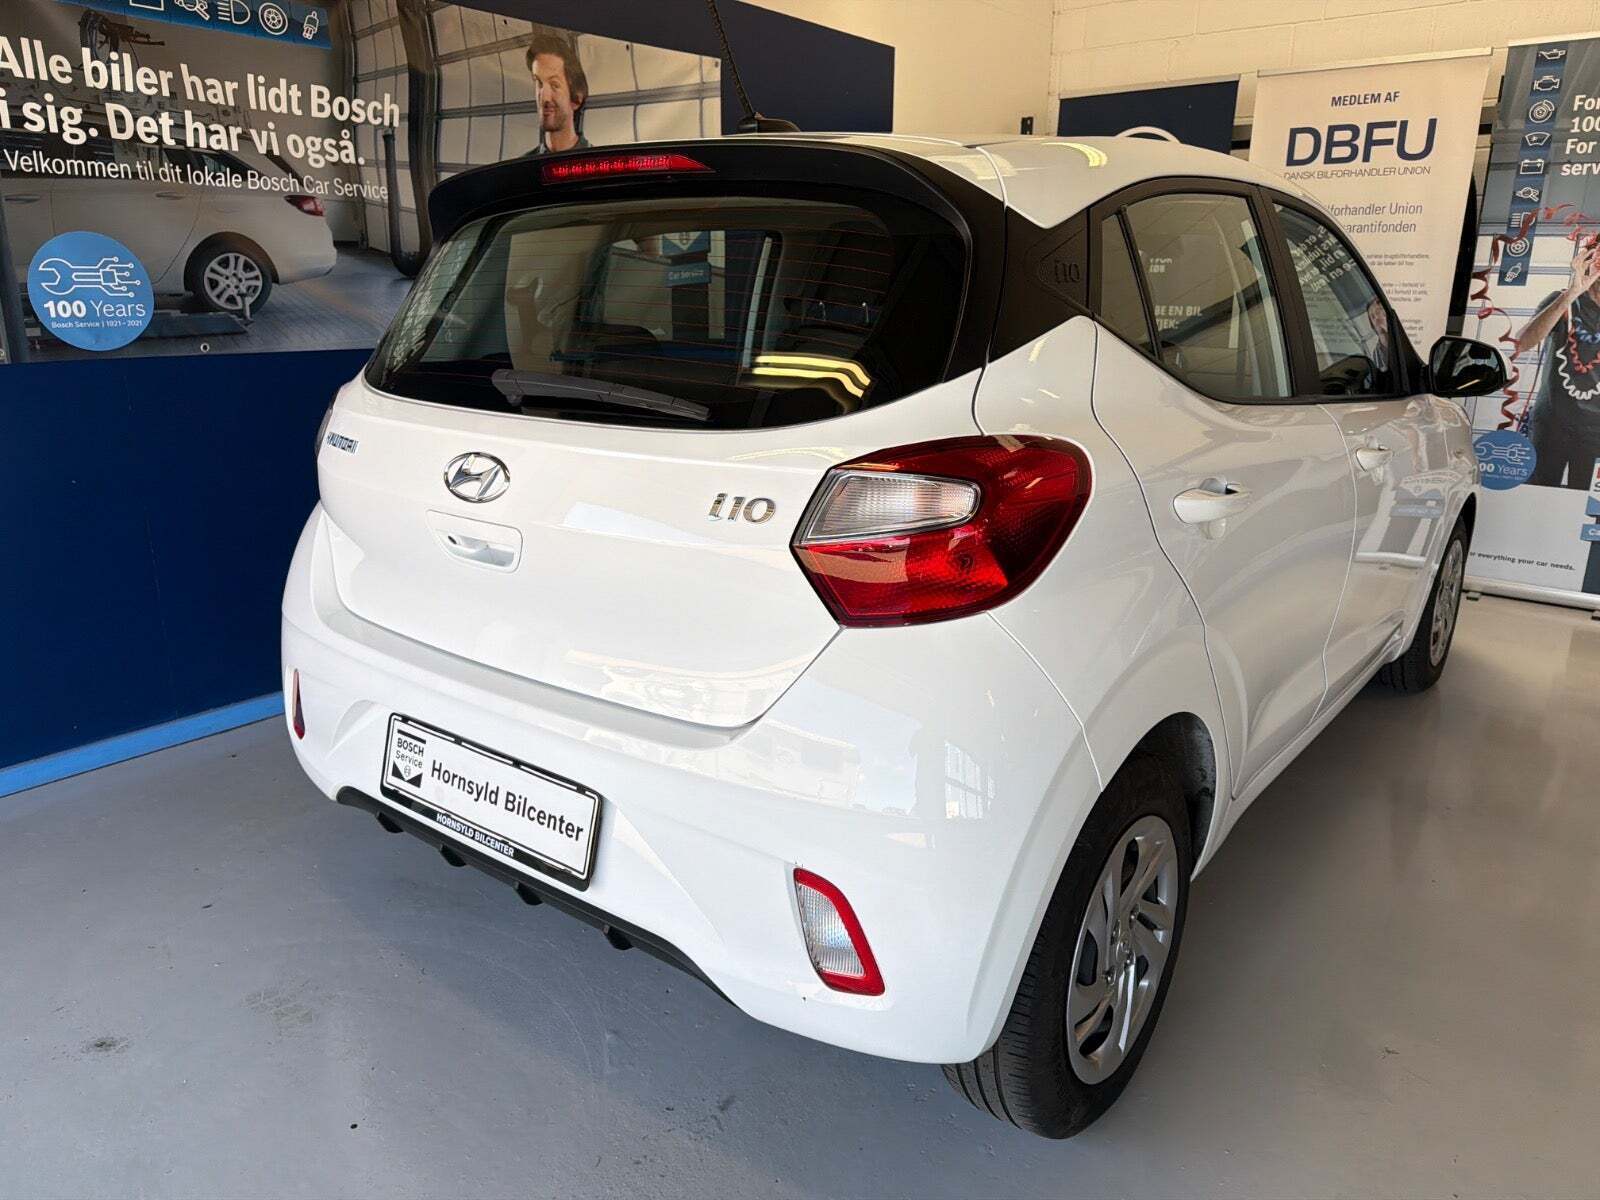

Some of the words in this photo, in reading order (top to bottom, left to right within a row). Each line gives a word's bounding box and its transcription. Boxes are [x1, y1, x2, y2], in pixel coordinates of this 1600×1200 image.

[0, 36, 73, 84] Alle
[81, 47, 174, 97] biler
[180, 63, 239, 107] har
[246, 73, 304, 116] lidt
[310, 83, 400, 128] Bosch
[1330, 92, 1382, 107] MEDLEM
[1384, 91, 1400, 104] AF
[0, 87, 11, 129] i
[22, 92, 99, 145] sig.
[105, 102, 176, 146] Det
[184, 110, 243, 152] har
[250, 121, 280, 156] vi
[286, 129, 366, 169] også.
[1286, 118, 1438, 167] DBFU
[1565, 138, 1597, 154] For
[3, 149, 132, 180] Velkommen
[136, 160, 155, 181] til
[158, 162, 184, 184] dit
[186, 164, 243, 189] lokale
[247, 170, 300, 193] Bosch
[303, 175, 330, 195] Car
[334, 177, 389, 200] Service
[1284, 172, 1317, 181] DANSK
[1317, 167, 1396, 179] BILFORHANDLER
[1397, 166, 1432, 176] UNION
[1328, 203, 1386, 216] forhandler
[1389, 203, 1423, 215] Union
[1343, 221, 1416, 234] arantifonden
[43, 300, 87, 318] 100
[90, 300, 146, 317] Years
[1168, 305, 1183, 316] EN
[1186, 305, 1203, 317] BIL
[51, 320, 74, 329] Bosch
[1479, 462, 1495, 473] 00
[1497, 464, 1528, 476] Years
[707, 492, 776, 524] i10
[1477, 552, 1516, 564] everything
[1550, 562, 1577, 571] needs.
[397, 737, 425, 757] BOSCH
[395, 750, 423, 768] Service
[431, 759, 500, 806] Hornsyld
[504, 790, 584, 842] Bilcenter
[435, 812, 474, 839] HORNSYLD
[474, 829, 515, 858] BILCENTER
